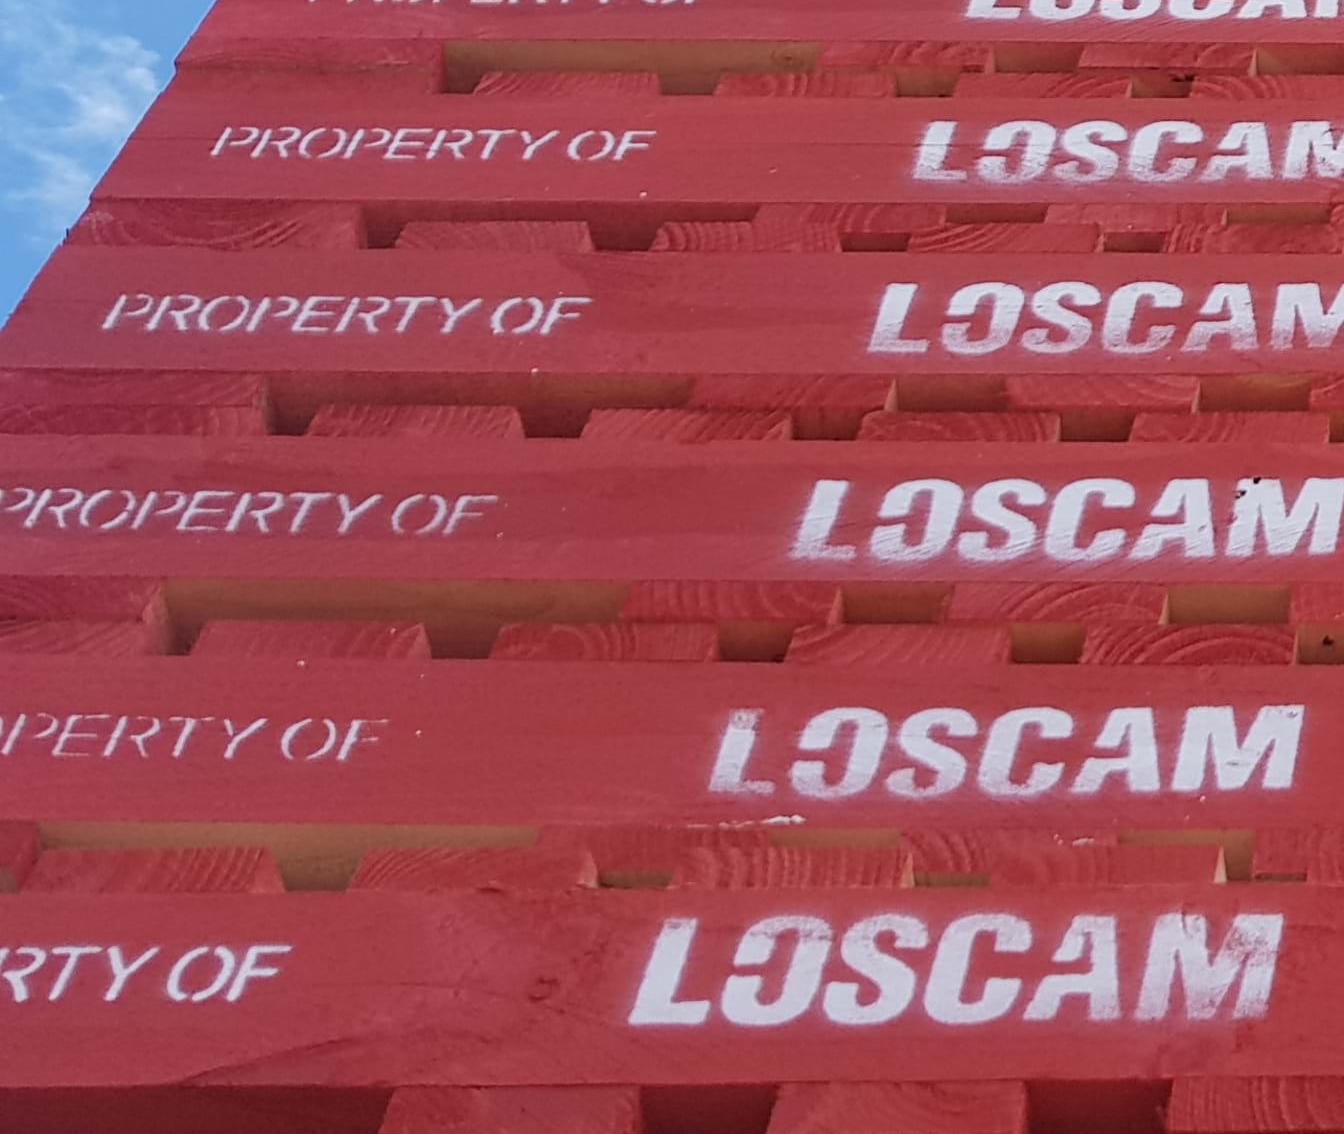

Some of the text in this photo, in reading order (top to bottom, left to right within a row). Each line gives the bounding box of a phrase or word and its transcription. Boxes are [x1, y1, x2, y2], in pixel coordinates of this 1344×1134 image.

[211, 127, 559, 159] PROPERTY
[567, 131, 656, 160] OF
[102, 294, 482, 333] PROPERTY
[491, 298, 591, 335] OF
[392, 494, 497, 533] OF
[0, 705, 1304, 798] PERTY OF LOSCAM
[167, 945, 291, 1002] OF
[629, 913, 1283, 1025] LOSCAM
